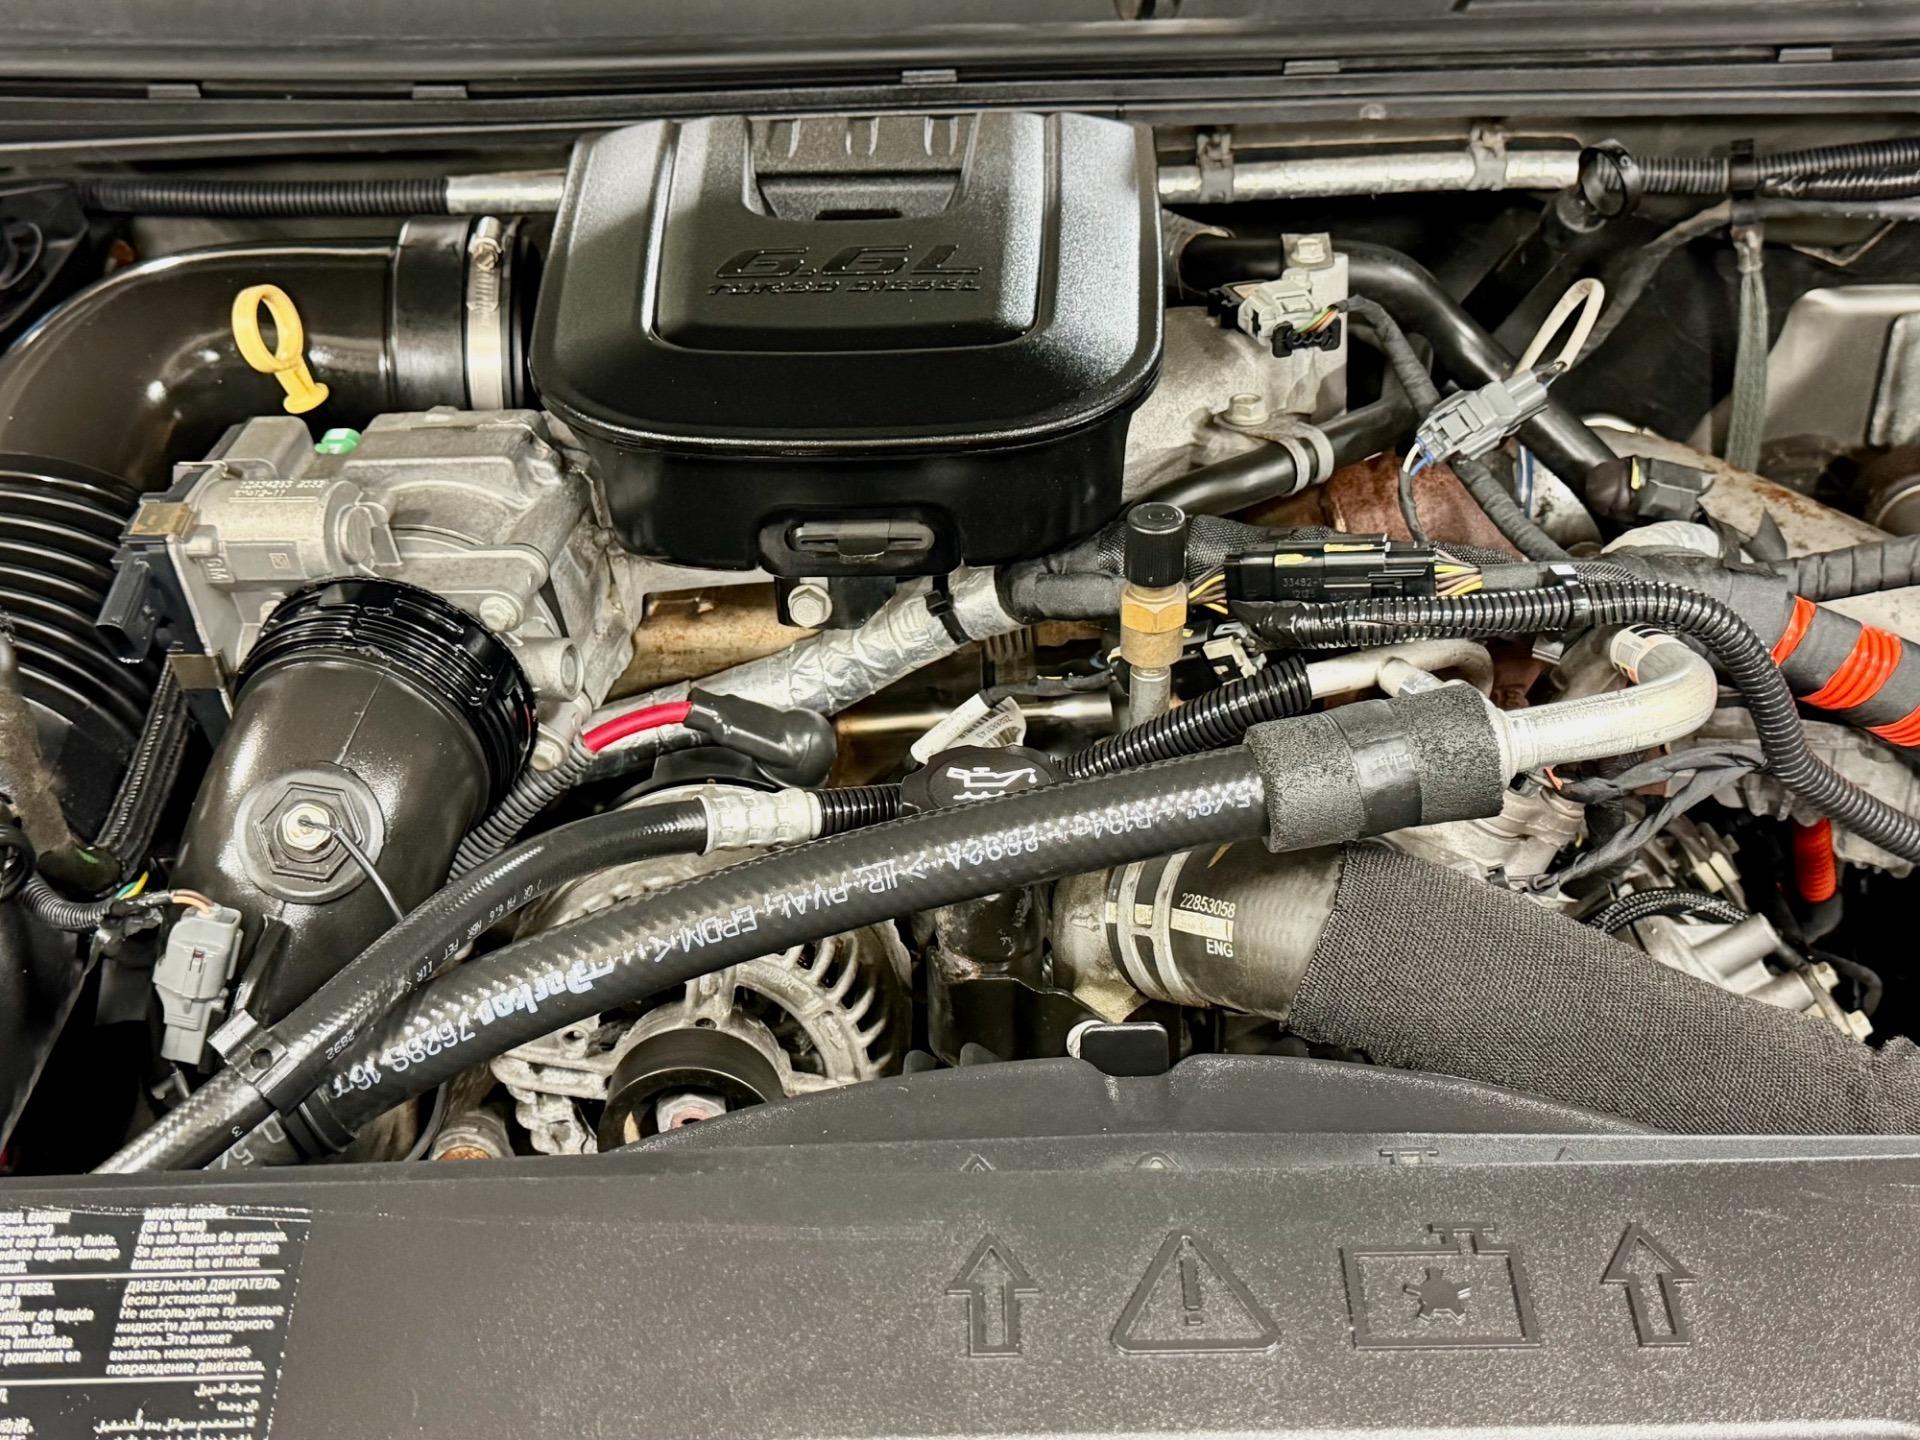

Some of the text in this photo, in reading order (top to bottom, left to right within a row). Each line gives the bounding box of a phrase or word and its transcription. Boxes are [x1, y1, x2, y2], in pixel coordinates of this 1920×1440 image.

[715, 244, 983, 279] 6.6L
[707, 279, 982, 295] TURBO DIESEL
[1179, 892, 1237, 919] 22853058
[680, 905, 757, 953] EPDM
[1206, 938, 1235, 958] ENG
[38, 1234, 82, 1249] starting
[137, 1232, 154, 1245] No
[155, 1233, 178, 1244] use
[179, 1231, 217, 1244] fluidos
[218, 1231, 234, 1243] de
[34, 1248, 74, 1262] engine
[74, 1246, 121, 1262] damage
[134, 1245, 150, 1258] Se
[151, 1244, 194, 1259] pueden
[194, 1243, 244, 1258] producir
[194, 1258, 211, 1269] en
[14, 1281, 56, 1296] DIESEL
[124, 1277, 281, 1294] ДИЗЕЛЬНЫЙ ДВИГАТЕЛЬ
[37, 1308, 54, 1322] de
[119, 1307, 138, 1320] Не
[222, 1304, 285, 1318] пусковые
[31, 1322, 56, 1336] Des
[179, 1321, 204, 1333] для
[205, 1318, 275, 1333] холодного
[190, 1333, 233, 1346] может
[64, 1350, 82, 1363] en
[109, 1348, 162, 1361] вызвать
[105, 1360, 196, 1376] повреждение
